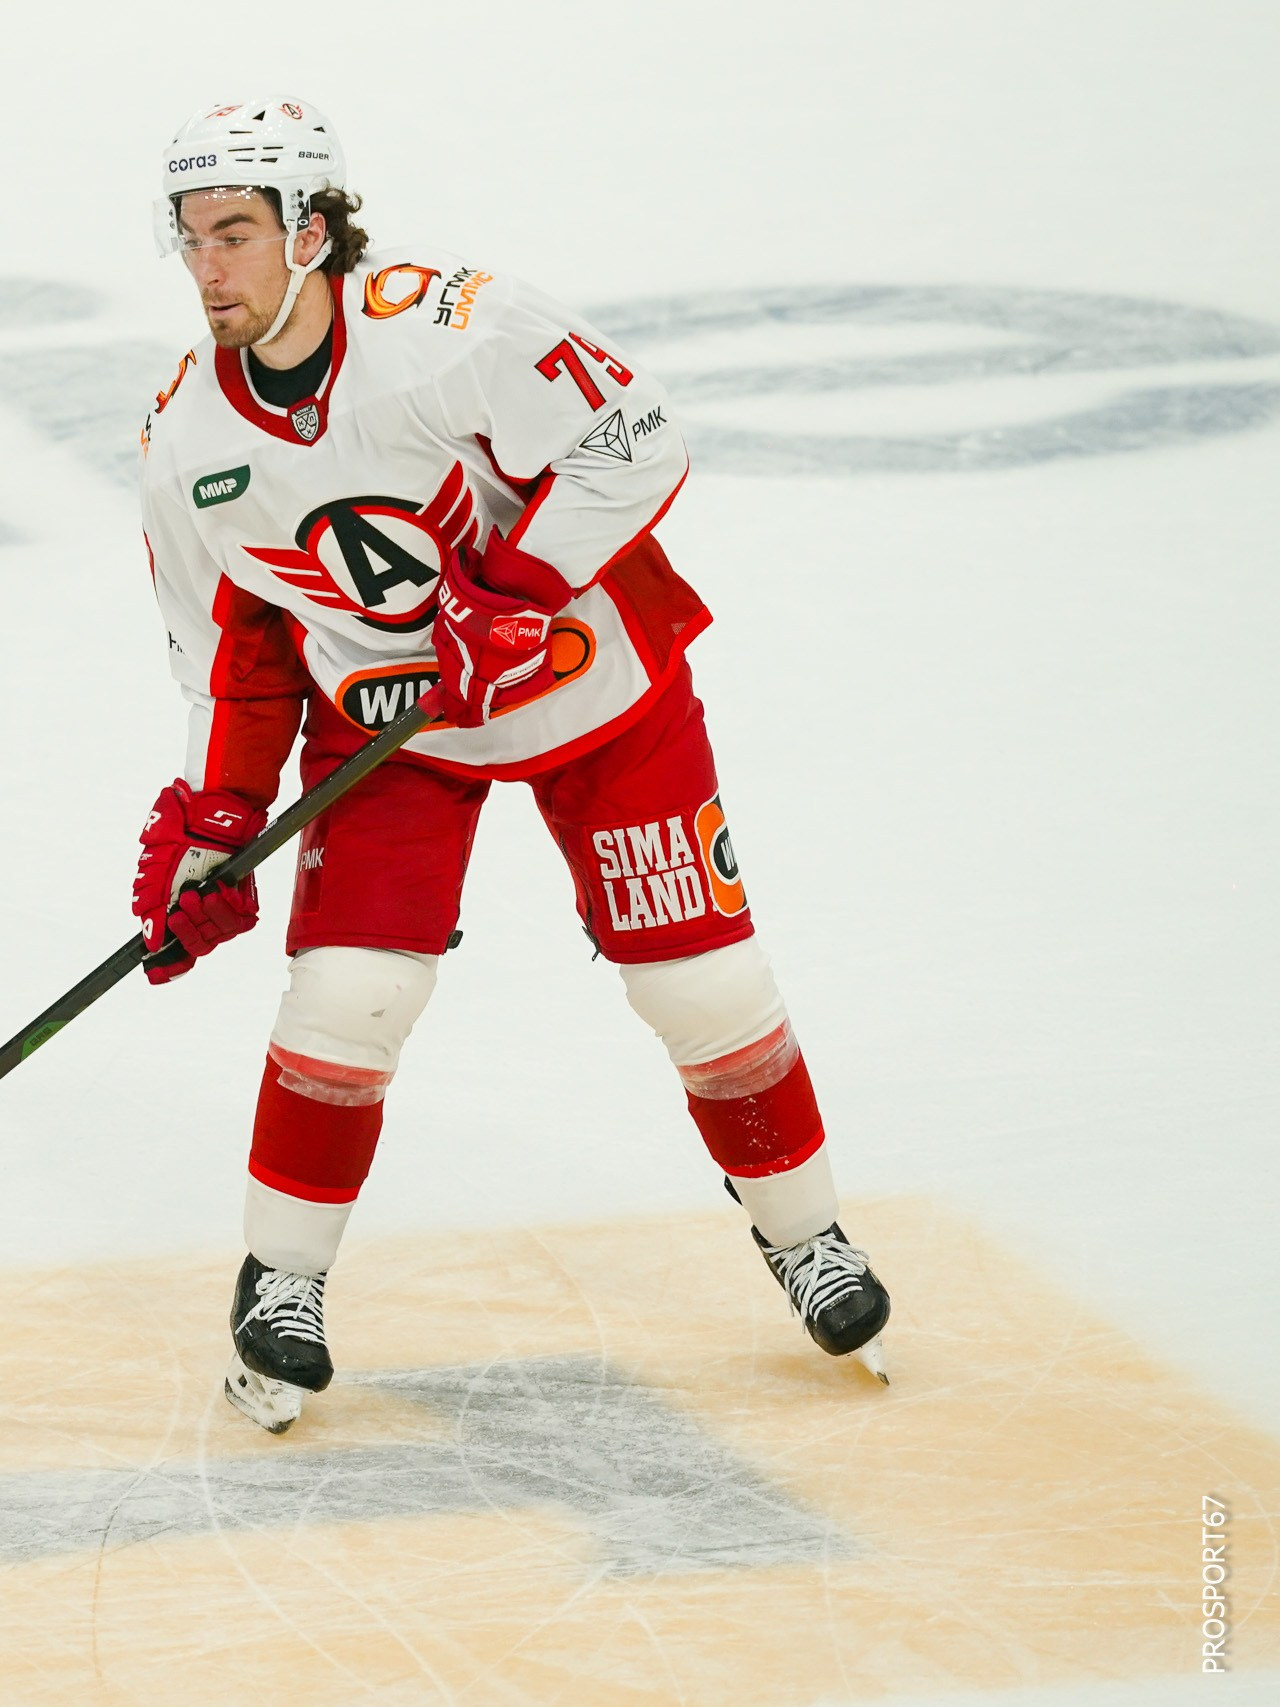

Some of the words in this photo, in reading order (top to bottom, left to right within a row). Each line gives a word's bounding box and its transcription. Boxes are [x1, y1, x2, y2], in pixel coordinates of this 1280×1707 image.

[168, 154, 218, 173] согаз
[198, 477, 238, 500] МИР
[592, 815, 696, 880] SIMA
[603, 865, 706, 932] LAND
